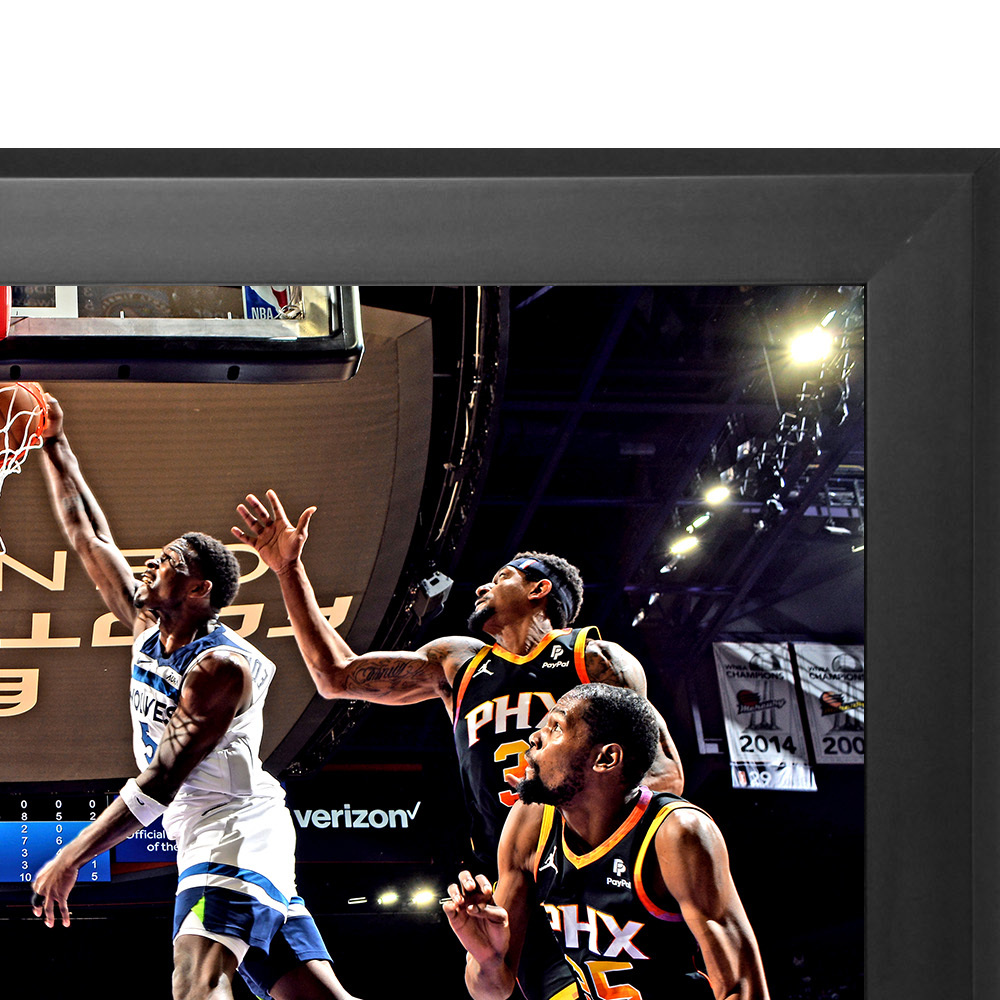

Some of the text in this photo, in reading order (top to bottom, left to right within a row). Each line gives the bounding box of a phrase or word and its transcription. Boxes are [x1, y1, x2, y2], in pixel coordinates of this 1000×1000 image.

[251, 307, 273, 320] NBA
[542, 660, 570, 669] PayPal
[726, 670, 785, 680] CHAMPIONS
[740, 735, 797, 754] 2014
[21, 800, 28, 809] 0
[55, 800, 63, 809] 0
[89, 800, 96, 809] 0
[21, 812, 28, 821] 8
[55, 812, 63, 821] 5
[89, 812, 97, 821] 2
[293, 803, 409, 828] verizon
[21, 825, 28, 833] 2
[55, 825, 63, 833] 0
[21, 837, 28, 845] 7
[55, 837, 63, 845] 6
[147, 842, 160, 852] of
[21, 849, 28, 857] 3
[21, 861, 28, 869] 3
[91, 860, 97, 869] 1
[19, 873, 32, 882] 10
[91, 872, 98, 881] 5
